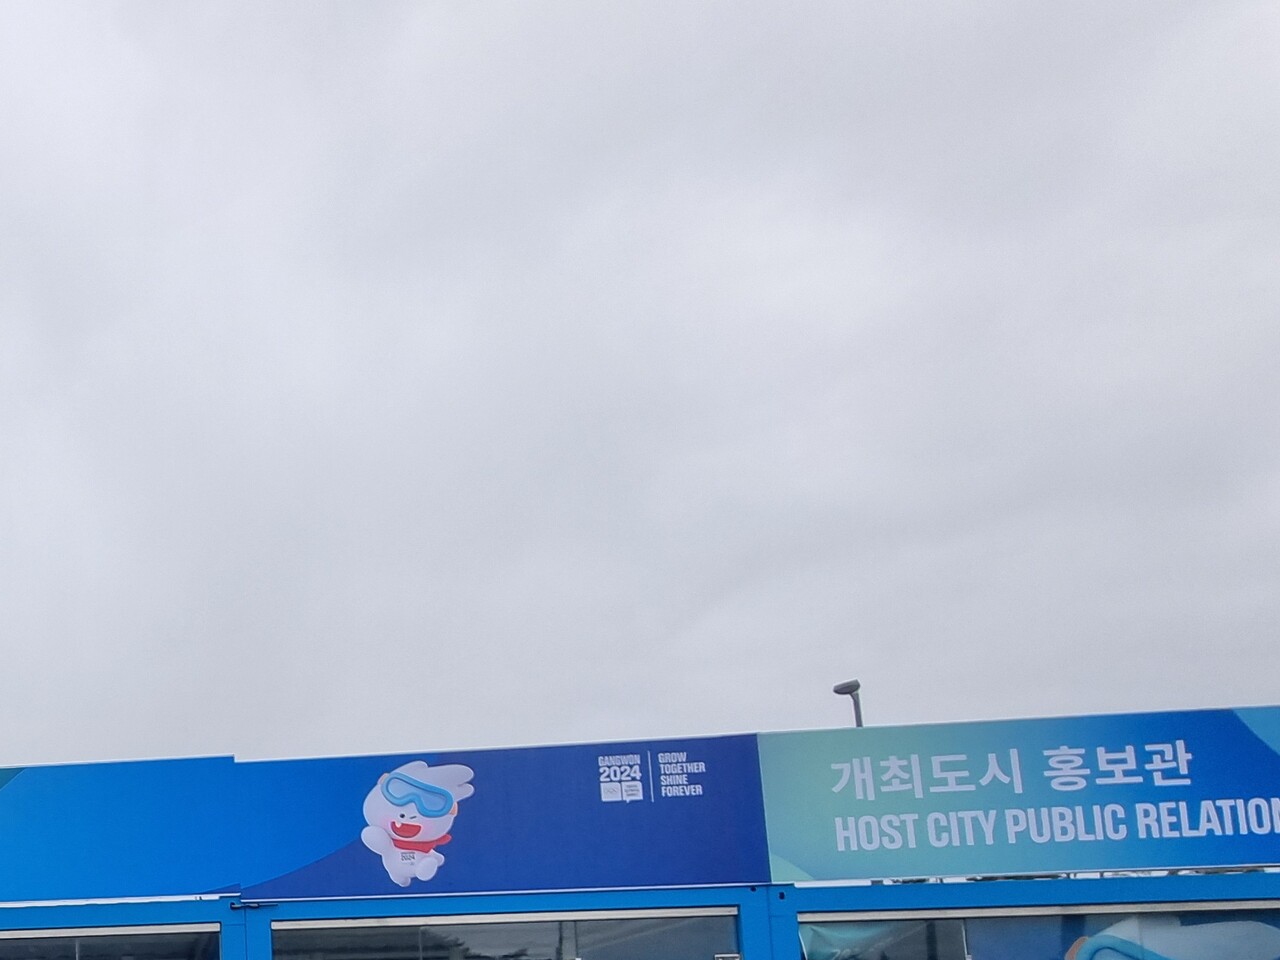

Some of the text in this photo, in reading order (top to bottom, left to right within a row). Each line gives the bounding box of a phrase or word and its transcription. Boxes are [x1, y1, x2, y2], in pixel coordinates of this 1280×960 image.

[598, 754, 641, 766] GANGWON
[658, 752, 687, 763] GROW
[599, 765, 642, 782] 2024
[660, 762, 706, 774] TOGETHER
[831, 739, 1193, 801] 개최도시 홍보관
[660, 774, 688, 786] SHINE
[661, 784, 703, 797] FOREVER
[834, 813, 919, 852] HOST
[927, 809, 997, 850] CITY
[1005, 804, 1128, 845] PUBLIC
